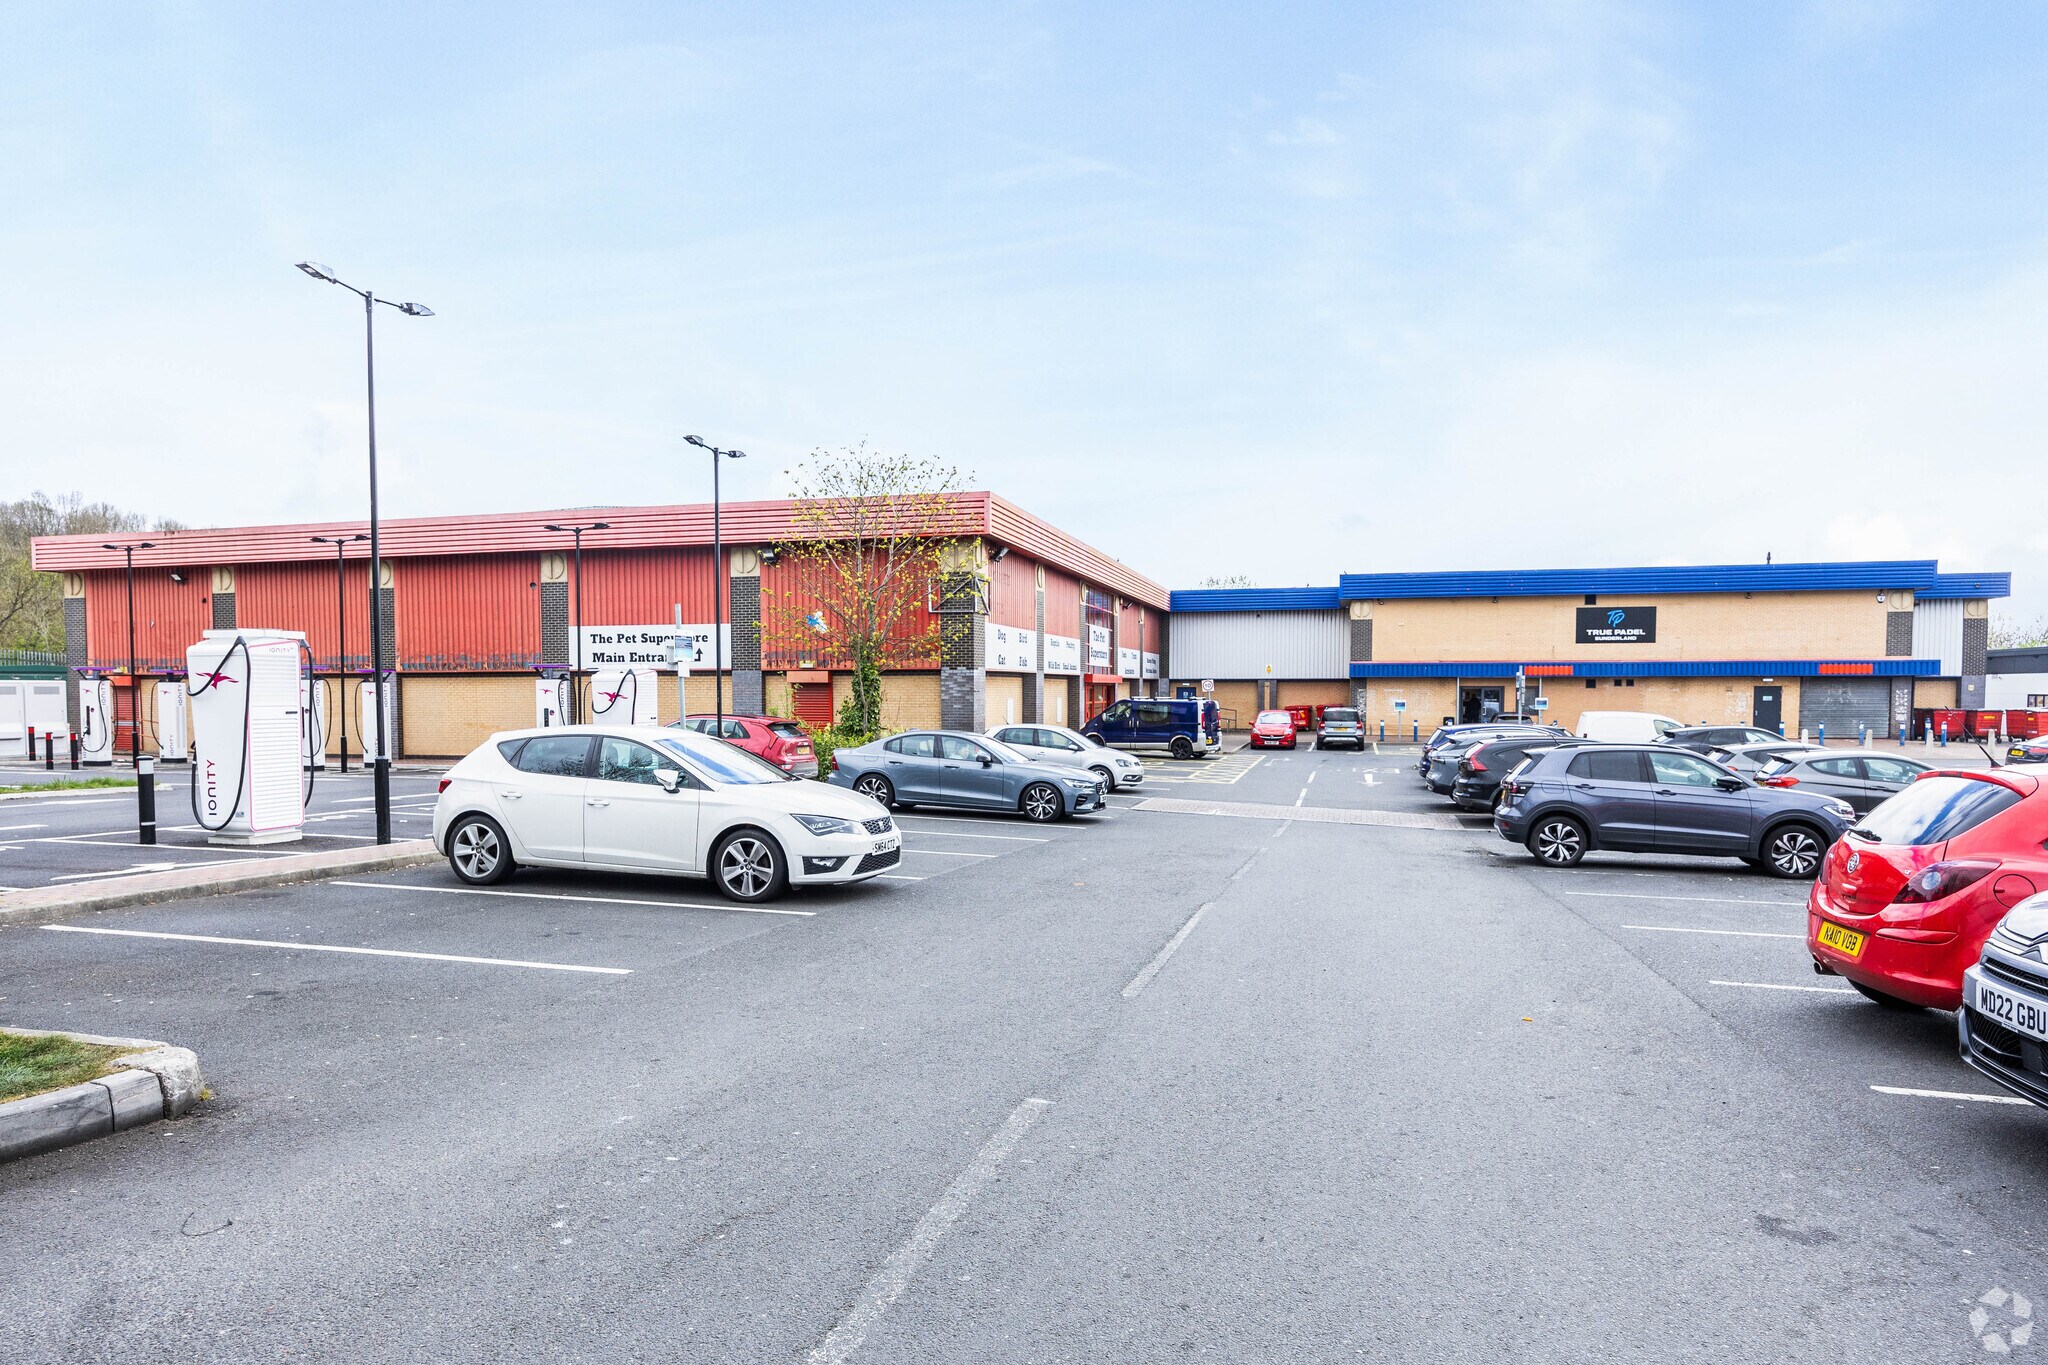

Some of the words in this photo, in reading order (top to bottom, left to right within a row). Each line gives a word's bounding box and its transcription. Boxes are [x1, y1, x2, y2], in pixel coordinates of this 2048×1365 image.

[590, 633, 613, 644] The
[616, 633, 637, 644] Pet
[997, 629, 1006, 643] Dog
[592, 652, 625, 663] Main
[998, 654, 1006, 665] Cat
[206, 759, 217, 816] IONITY
[1981, 987, 2013, 1022] MD22
[2017, 1002, 2047, 1035] GBU
